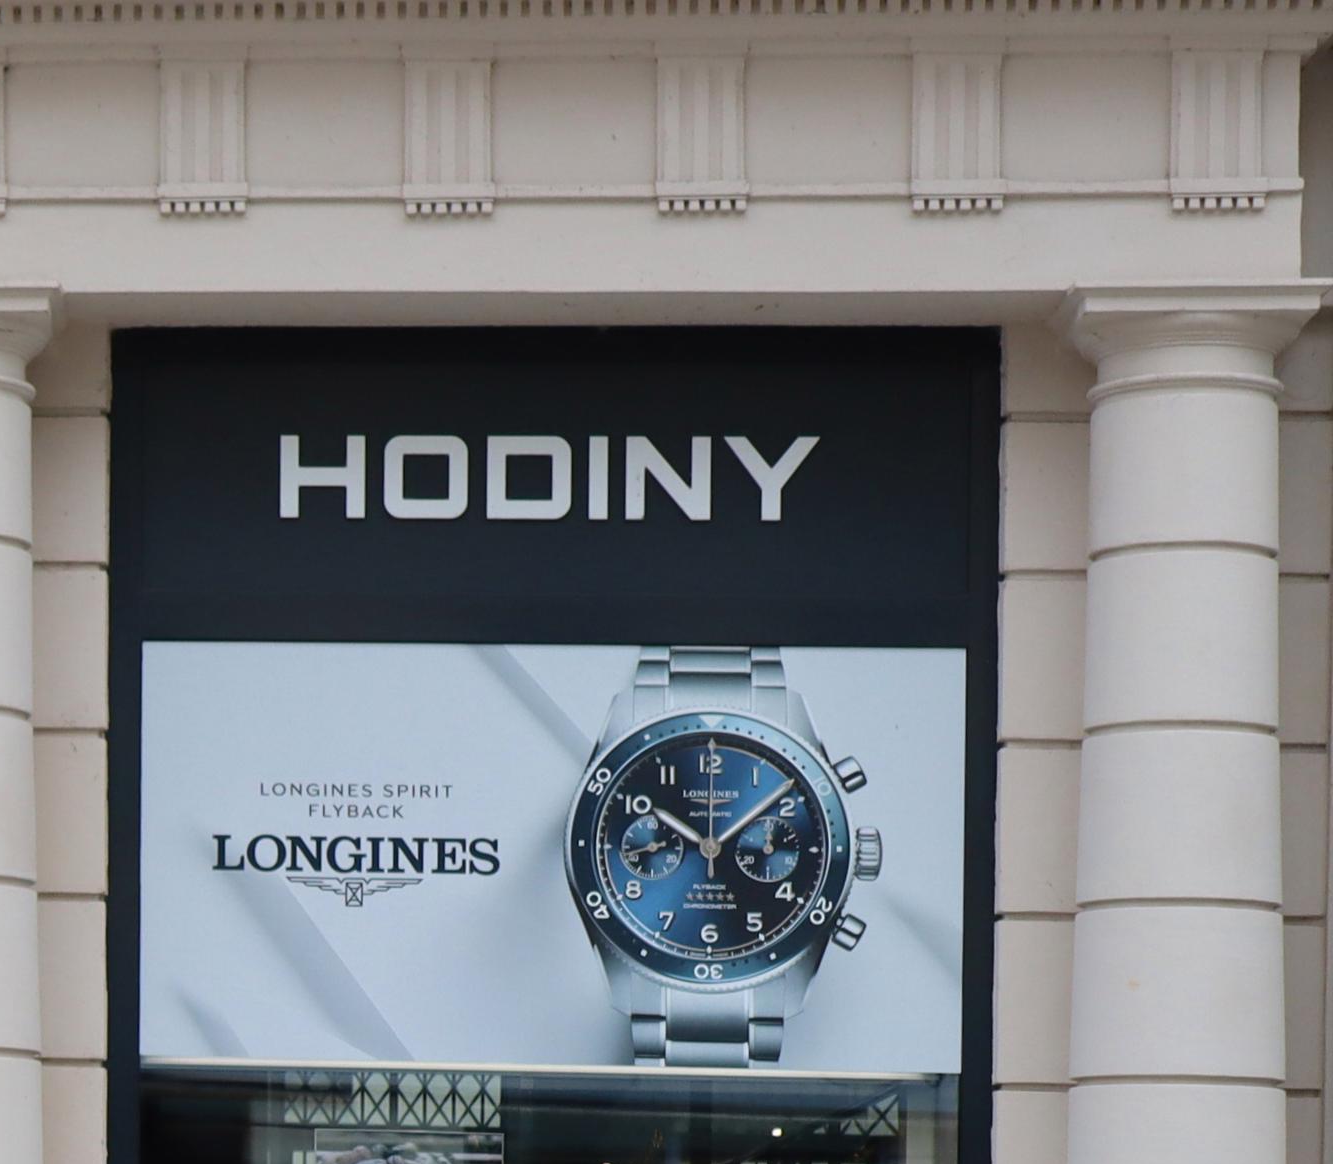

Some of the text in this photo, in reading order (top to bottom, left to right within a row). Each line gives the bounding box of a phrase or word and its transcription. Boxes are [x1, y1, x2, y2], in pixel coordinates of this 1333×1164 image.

[279, 434, 821, 522] HODINY
[698, 753, 724, 774] 12
[586, 767, 612, 796] 50
[659, 764, 676, 786] 11
[259, 782, 454, 799] LONGINES SPIRIT
[307, 803, 405, 819] FLYBACK
[624, 794, 653, 815] 10
[778, 797, 796, 818] 2
[211, 833, 501, 876] LONGINES
[624, 879, 643, 900] 8
[774, 881, 796, 902] 4
[585, 890, 611, 920] 40
[808, 895, 833, 926] 20
[658, 911, 675, 931] 7
[745, 911, 764, 933] 5
[700, 923, 719, 944] 6
[693, 962, 724, 980] 30
